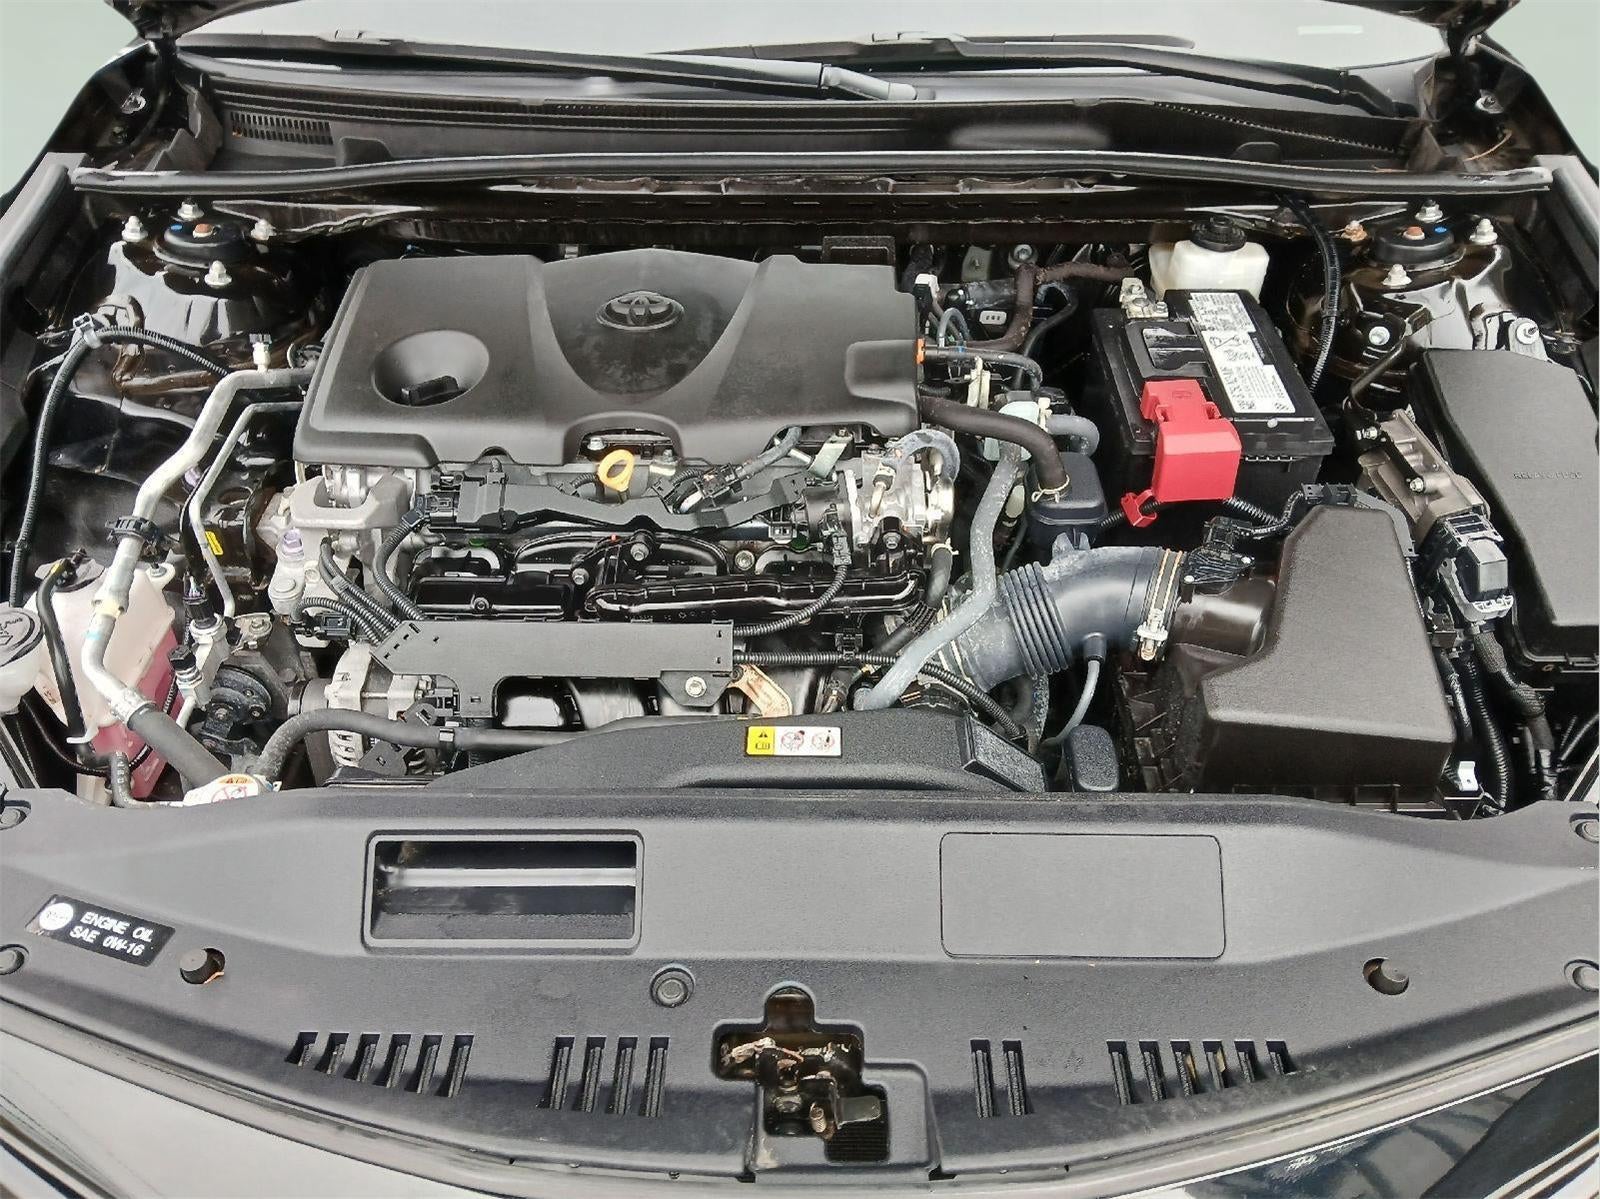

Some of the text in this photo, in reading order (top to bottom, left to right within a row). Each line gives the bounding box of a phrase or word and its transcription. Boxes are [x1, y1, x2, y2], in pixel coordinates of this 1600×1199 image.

[69, 926, 146, 957] SAE 0W-16
[80, 911, 130, 934] ENGINE
[132, 926, 154, 943] OIL
